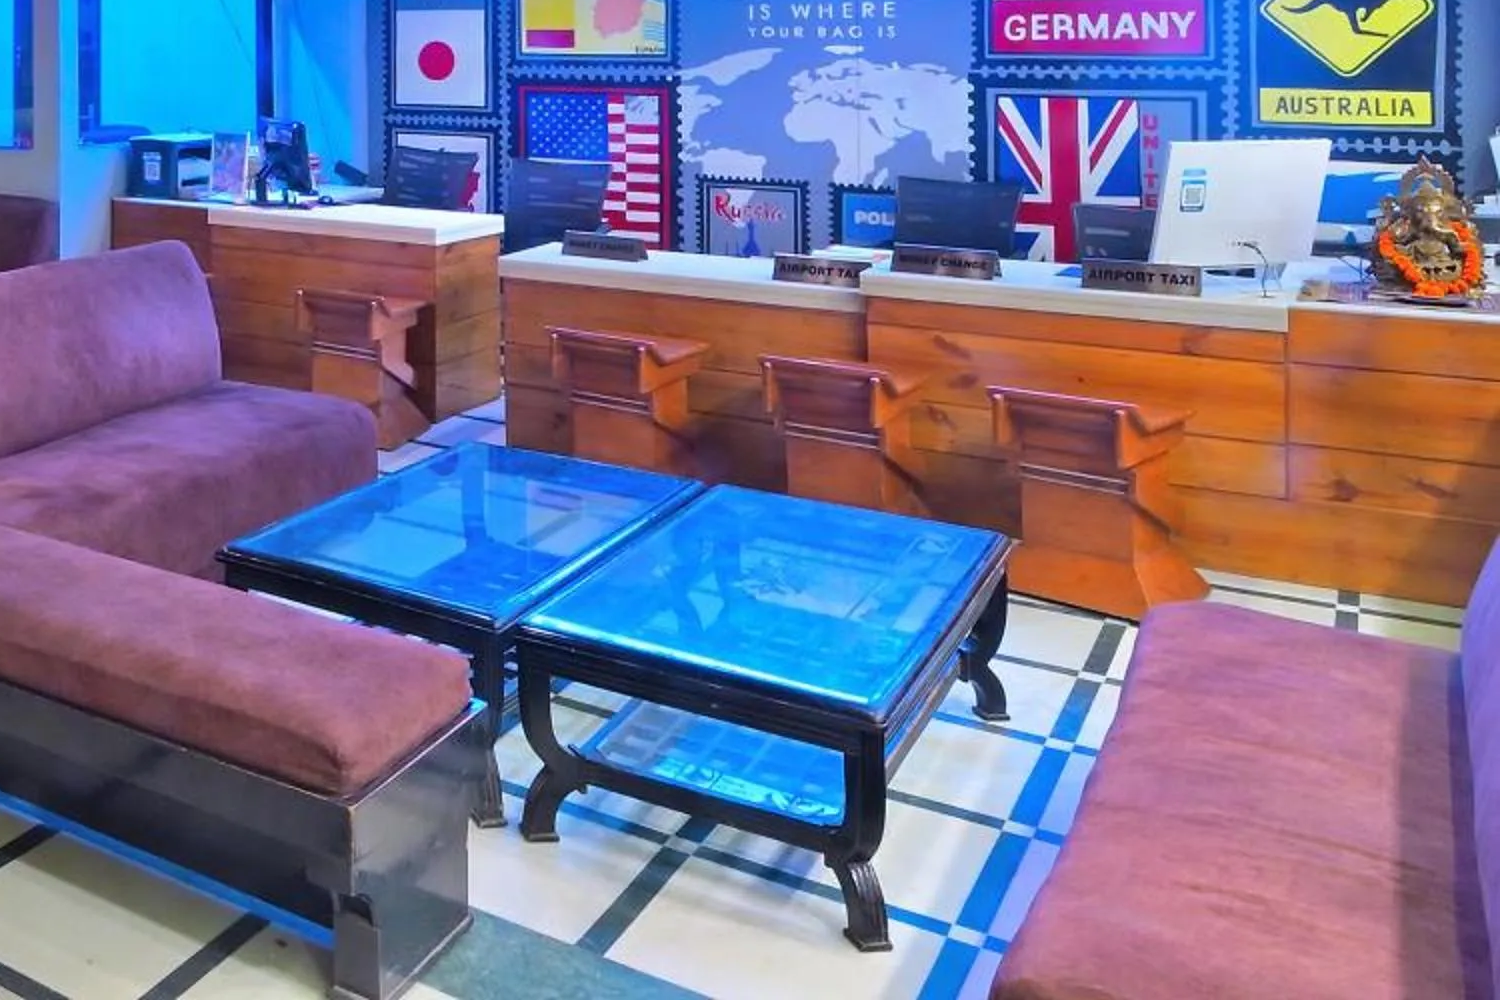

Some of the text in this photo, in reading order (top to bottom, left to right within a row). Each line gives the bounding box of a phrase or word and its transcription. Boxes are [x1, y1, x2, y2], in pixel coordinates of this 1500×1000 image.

[749, 1, 897, 21] IS WHERE
[748, 25, 897, 39] YOUR BAG IS
[1004, 11, 1196, 41] GERMANY
[1275, 96, 1415, 118] AUSTRALIA
[854, 210, 895, 227] POL
[779, 263, 835, 278] AIRPORT
[1088, 268, 1195, 286] AIRPORT TAXI
